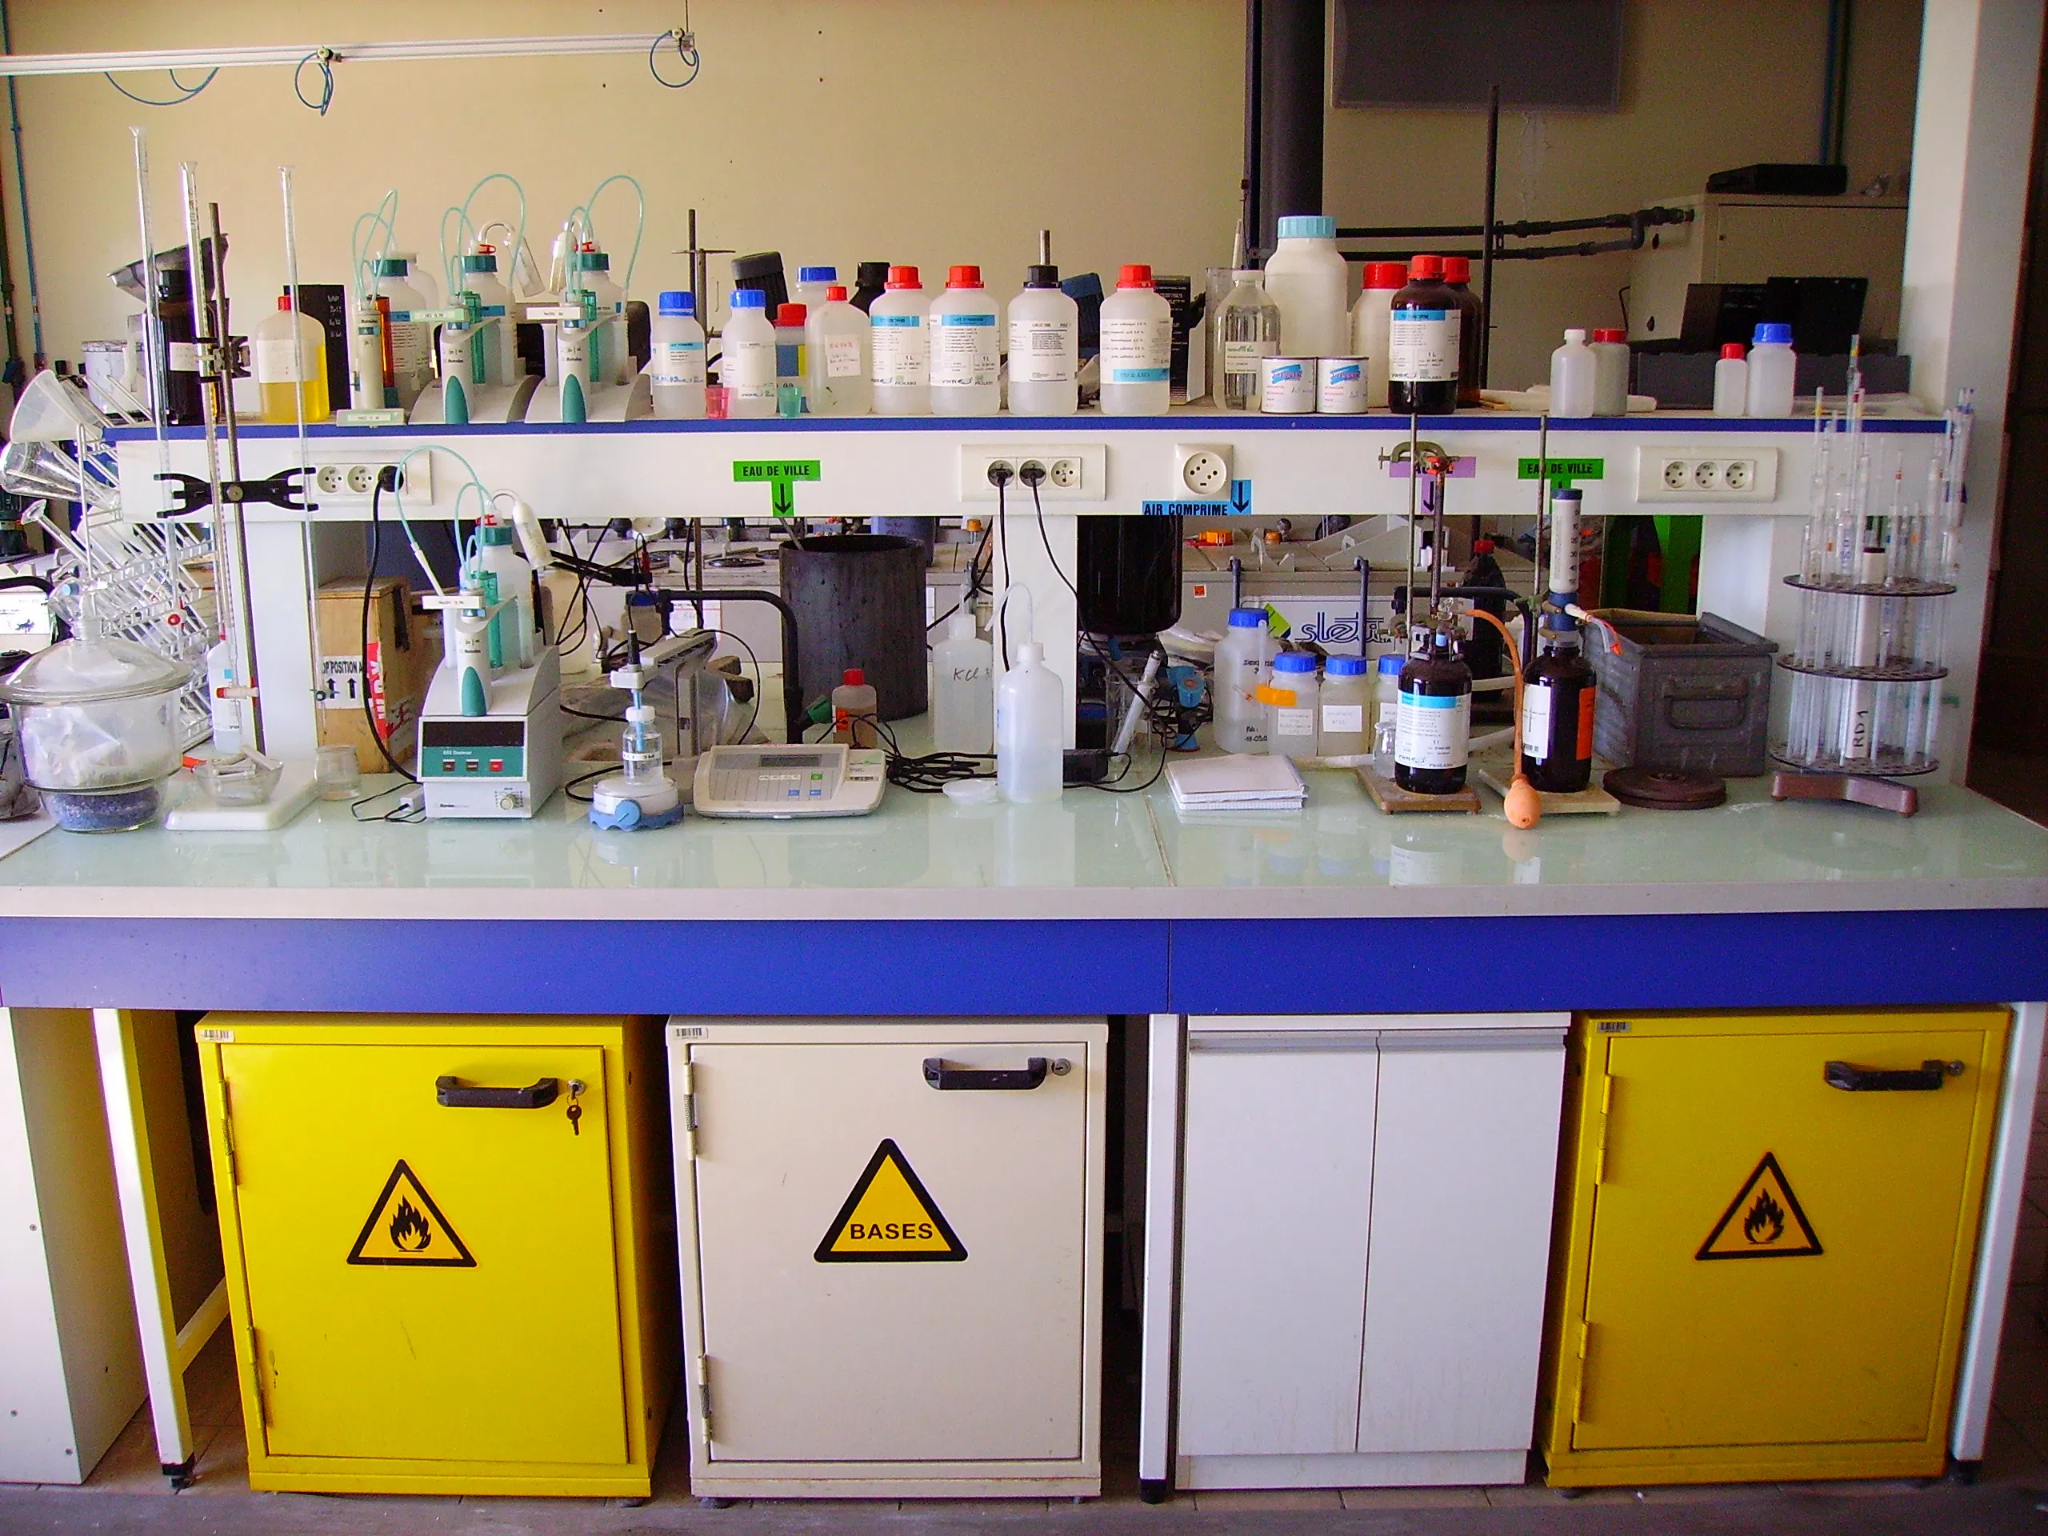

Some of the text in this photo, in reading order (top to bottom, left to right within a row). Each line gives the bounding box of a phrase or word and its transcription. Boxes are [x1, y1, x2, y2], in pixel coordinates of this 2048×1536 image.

[742, 465, 810, 477] EAU DE VILLE
[1550, 464, 1563, 474] DE
[1567, 463, 1594, 474] VILLE
[1144, 503, 1228, 515] AIR COMPRIME
[330, 661, 358, 674] POSITION
[850, 1223, 933, 1239] BASES
